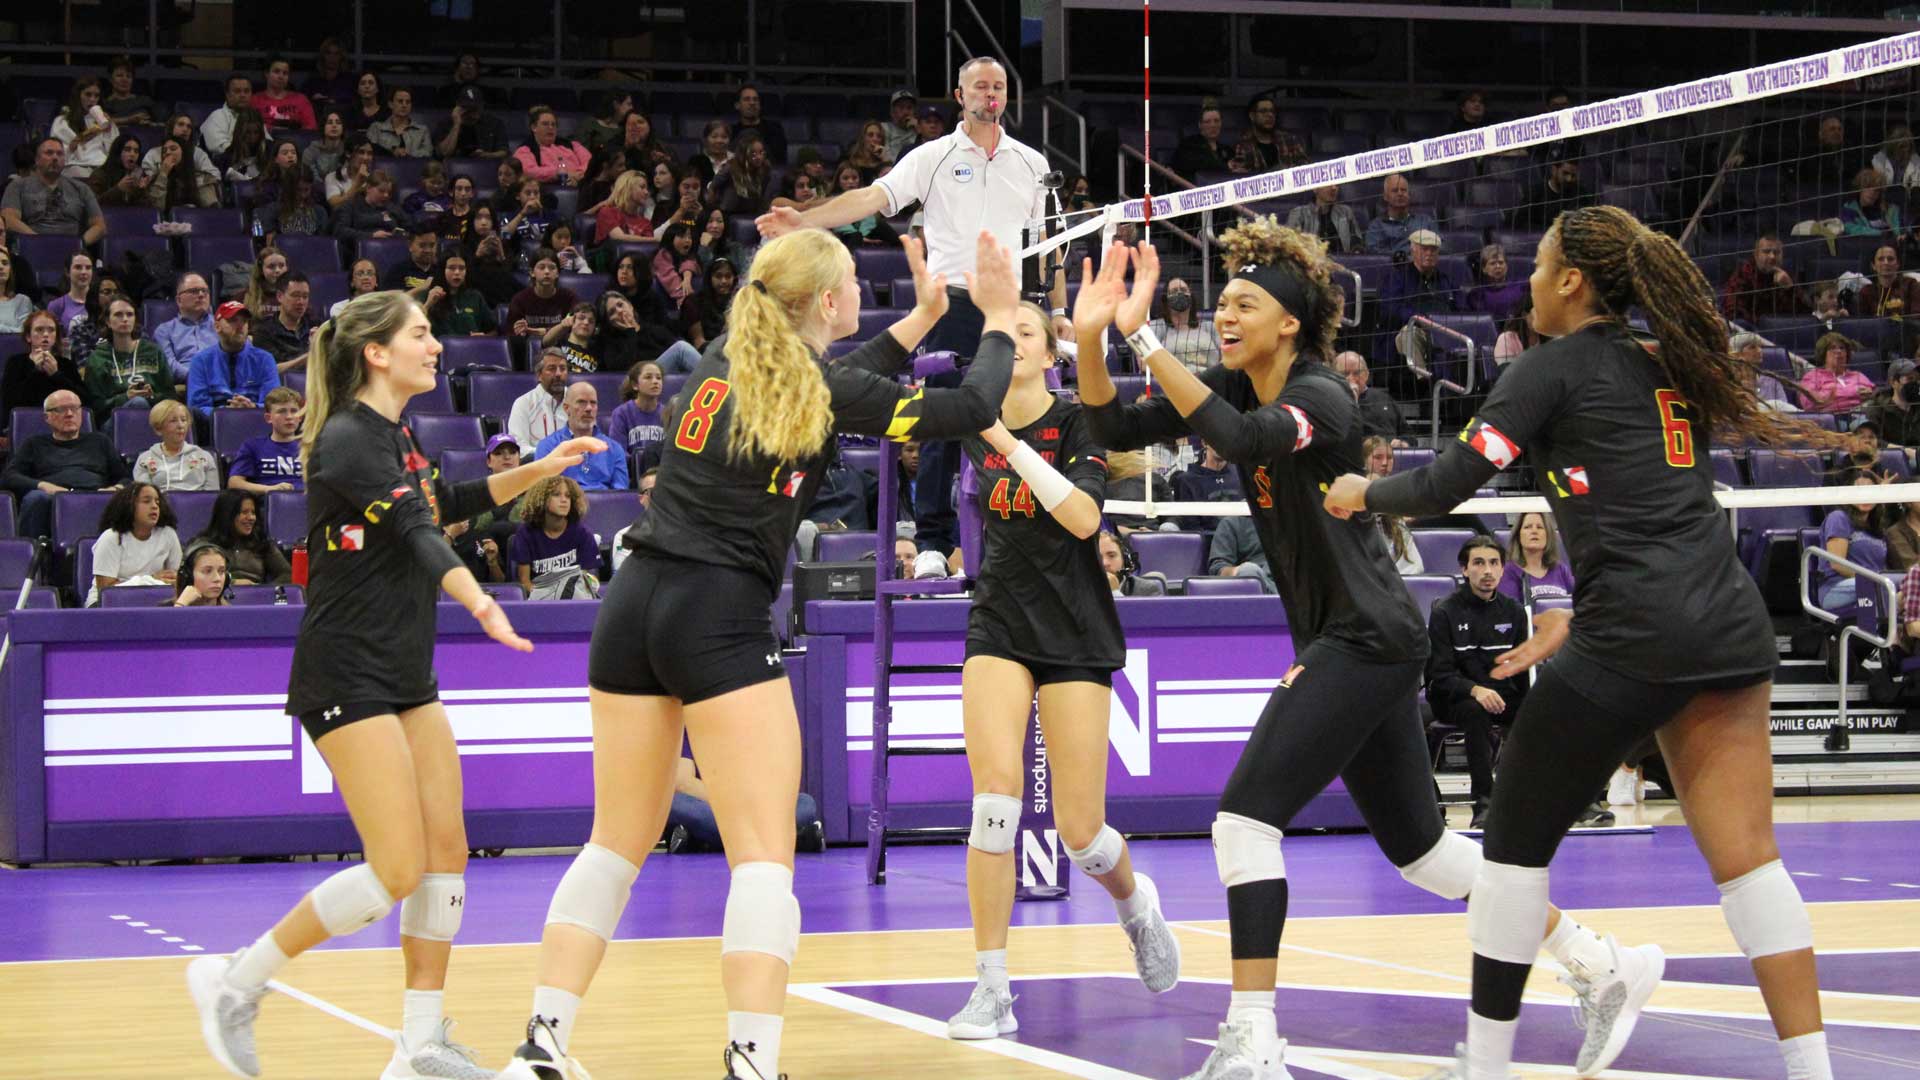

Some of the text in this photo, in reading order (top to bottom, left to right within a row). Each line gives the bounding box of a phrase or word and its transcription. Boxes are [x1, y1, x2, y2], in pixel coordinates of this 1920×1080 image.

[1233, 173, 1285, 199] NORTHWESTERN
[1292, 161, 1347, 187] NORTHWESTERN
[1355, 146, 1413, 175] NORTHWESTERN
[1422, 131, 1485, 162] NORTHWESTERN
[1495, 115, 1561, 147] NORTHWESTERN
[1572, 97, 1644, 131] NORTHWESTERN
[1655, 77, 1734, 112] NORTHWESTERN
[1746, 56, 1829, 94] NORTHWESTERN
[675, 377, 731, 453] 8
[1655, 388, 1695, 467] 6
[989, 477, 1036, 520] 44
[1769, 718, 1804, 731] WHILE
[1856, 716, 1870, 729] IN
[1871, 715, 1899, 729] PLAY
[1022, 829, 1058, 887] N
